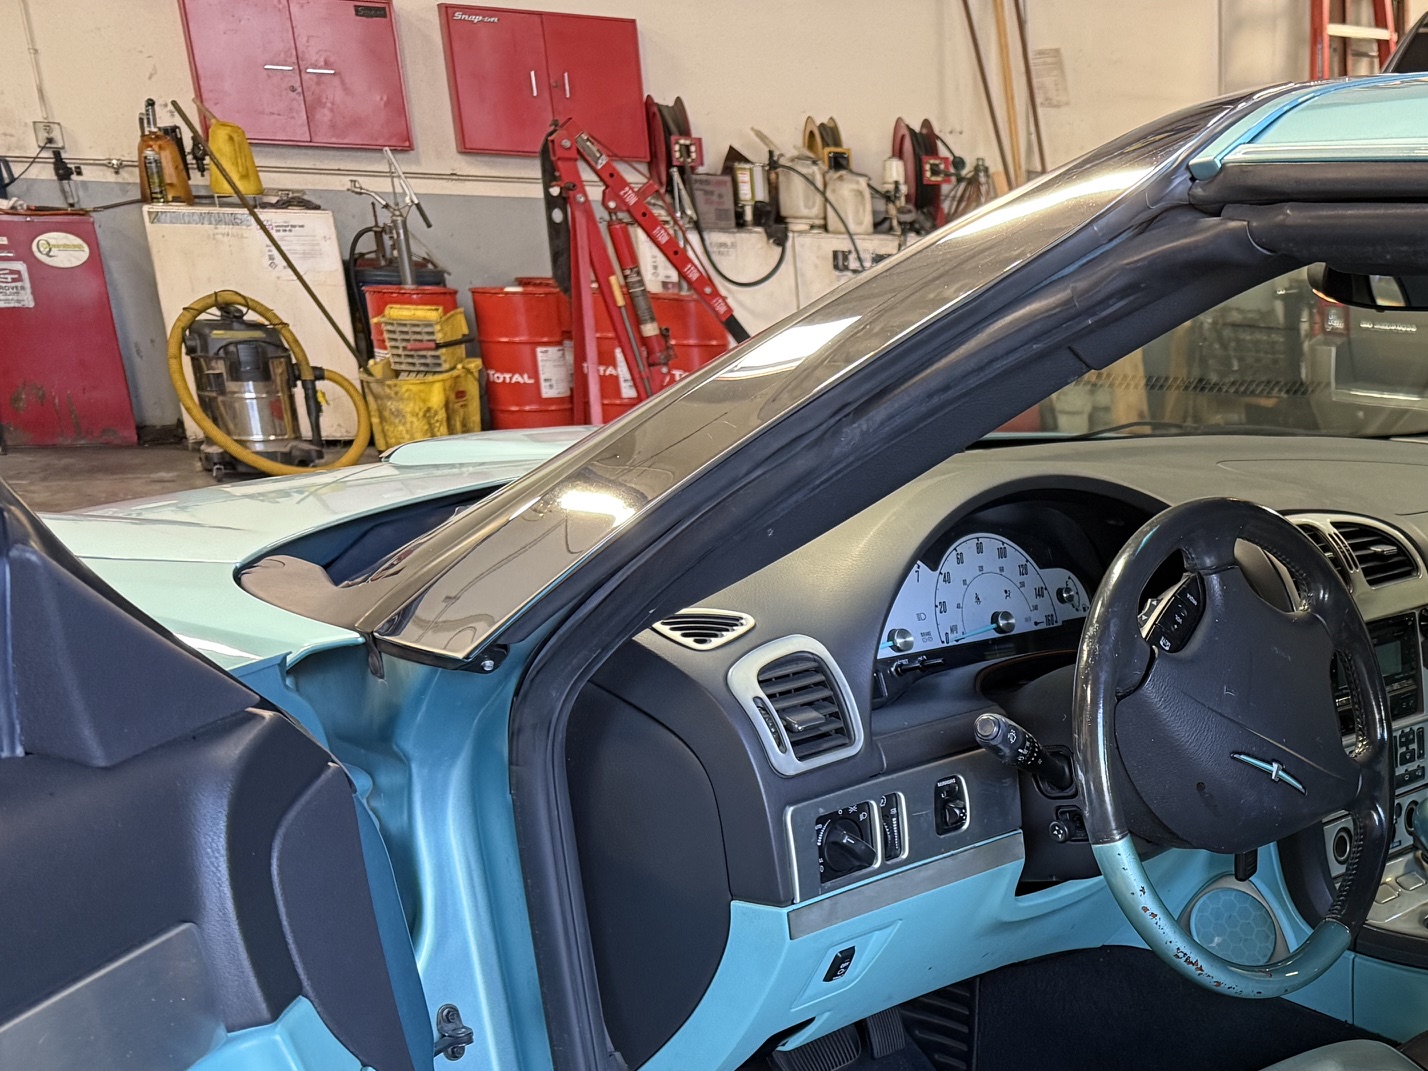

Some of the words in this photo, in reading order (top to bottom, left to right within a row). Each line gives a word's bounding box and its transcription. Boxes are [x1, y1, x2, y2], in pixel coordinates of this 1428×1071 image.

[453, 11, 499, 23] Snap-on
[486, 369, 535, 383] TOTAL
[976, 541, 984, 555] 80
[997, 546, 1008, 560] 100
[955, 552, 964, 565] 60
[1018, 563, 1029, 577] 120
[942, 571, 951, 584] 40
[1034, 586, 1045, 599] 140
[939, 600, 948, 614] 20
[1044, 613, 1055, 626] 160
